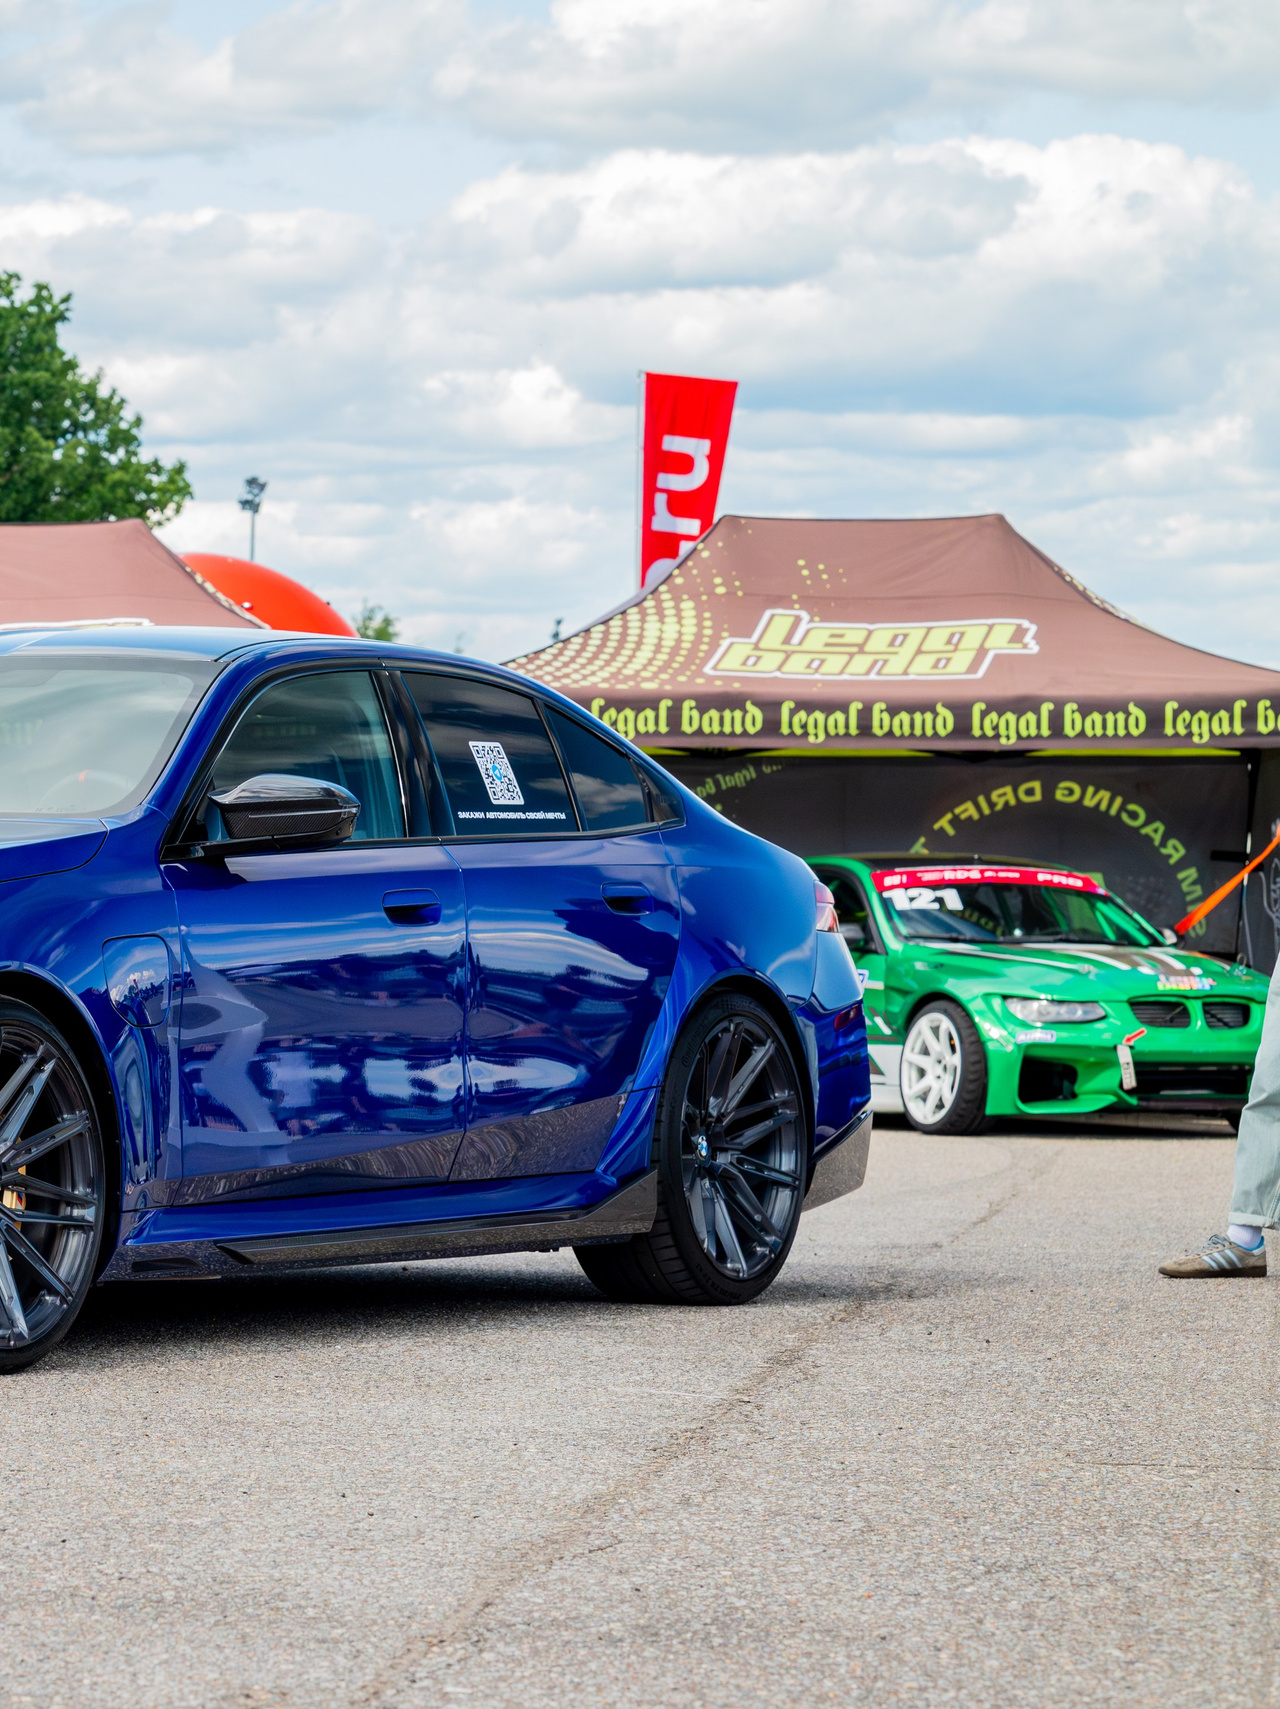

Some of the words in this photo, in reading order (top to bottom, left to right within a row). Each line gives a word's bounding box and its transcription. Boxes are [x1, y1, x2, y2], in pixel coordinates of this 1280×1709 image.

[591, 697, 673, 741] legal
[681, 698, 764, 735] band
[779, 700, 863, 744] legal
[872, 701, 954, 738] band
[971, 701, 1055, 745] legal
[1063, 701, 1147, 738] band
[1163, 699, 1248, 744] legal
[1256, 698, 1280, 735] b
[882, 887, 964, 911] 121
